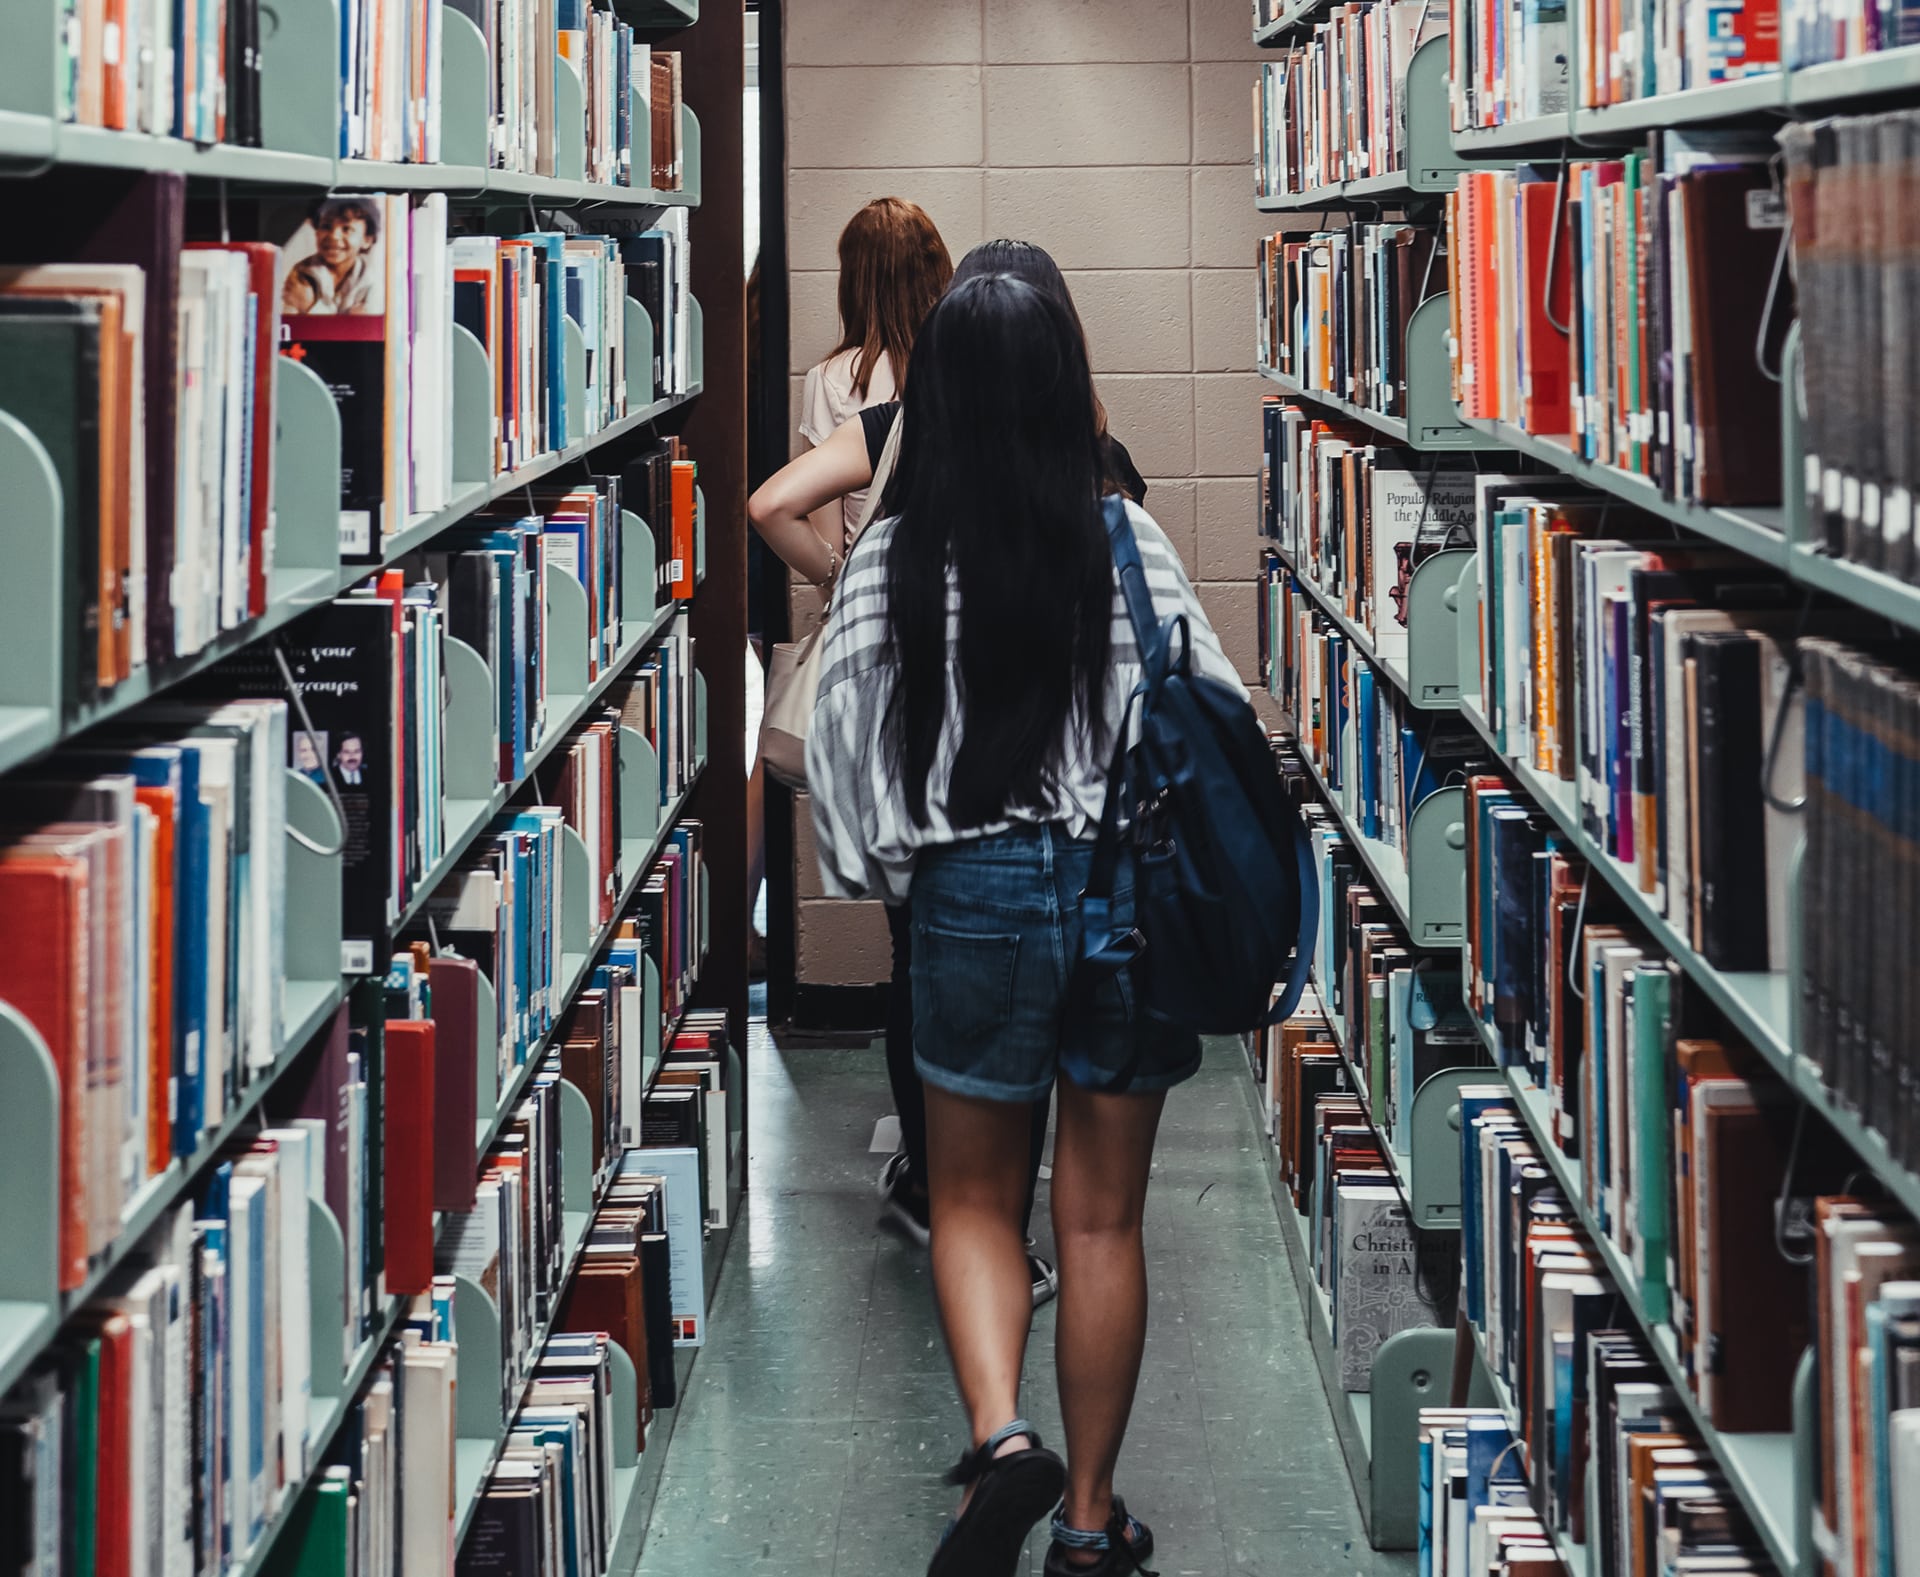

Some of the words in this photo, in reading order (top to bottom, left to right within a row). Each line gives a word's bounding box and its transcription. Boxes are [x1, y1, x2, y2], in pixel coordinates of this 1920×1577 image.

[1387, 491, 1430, 507] Popula
[1394, 509, 1412, 522] the
[311, 647, 356, 662] your
[1373, 1258, 1390, 1275] in
